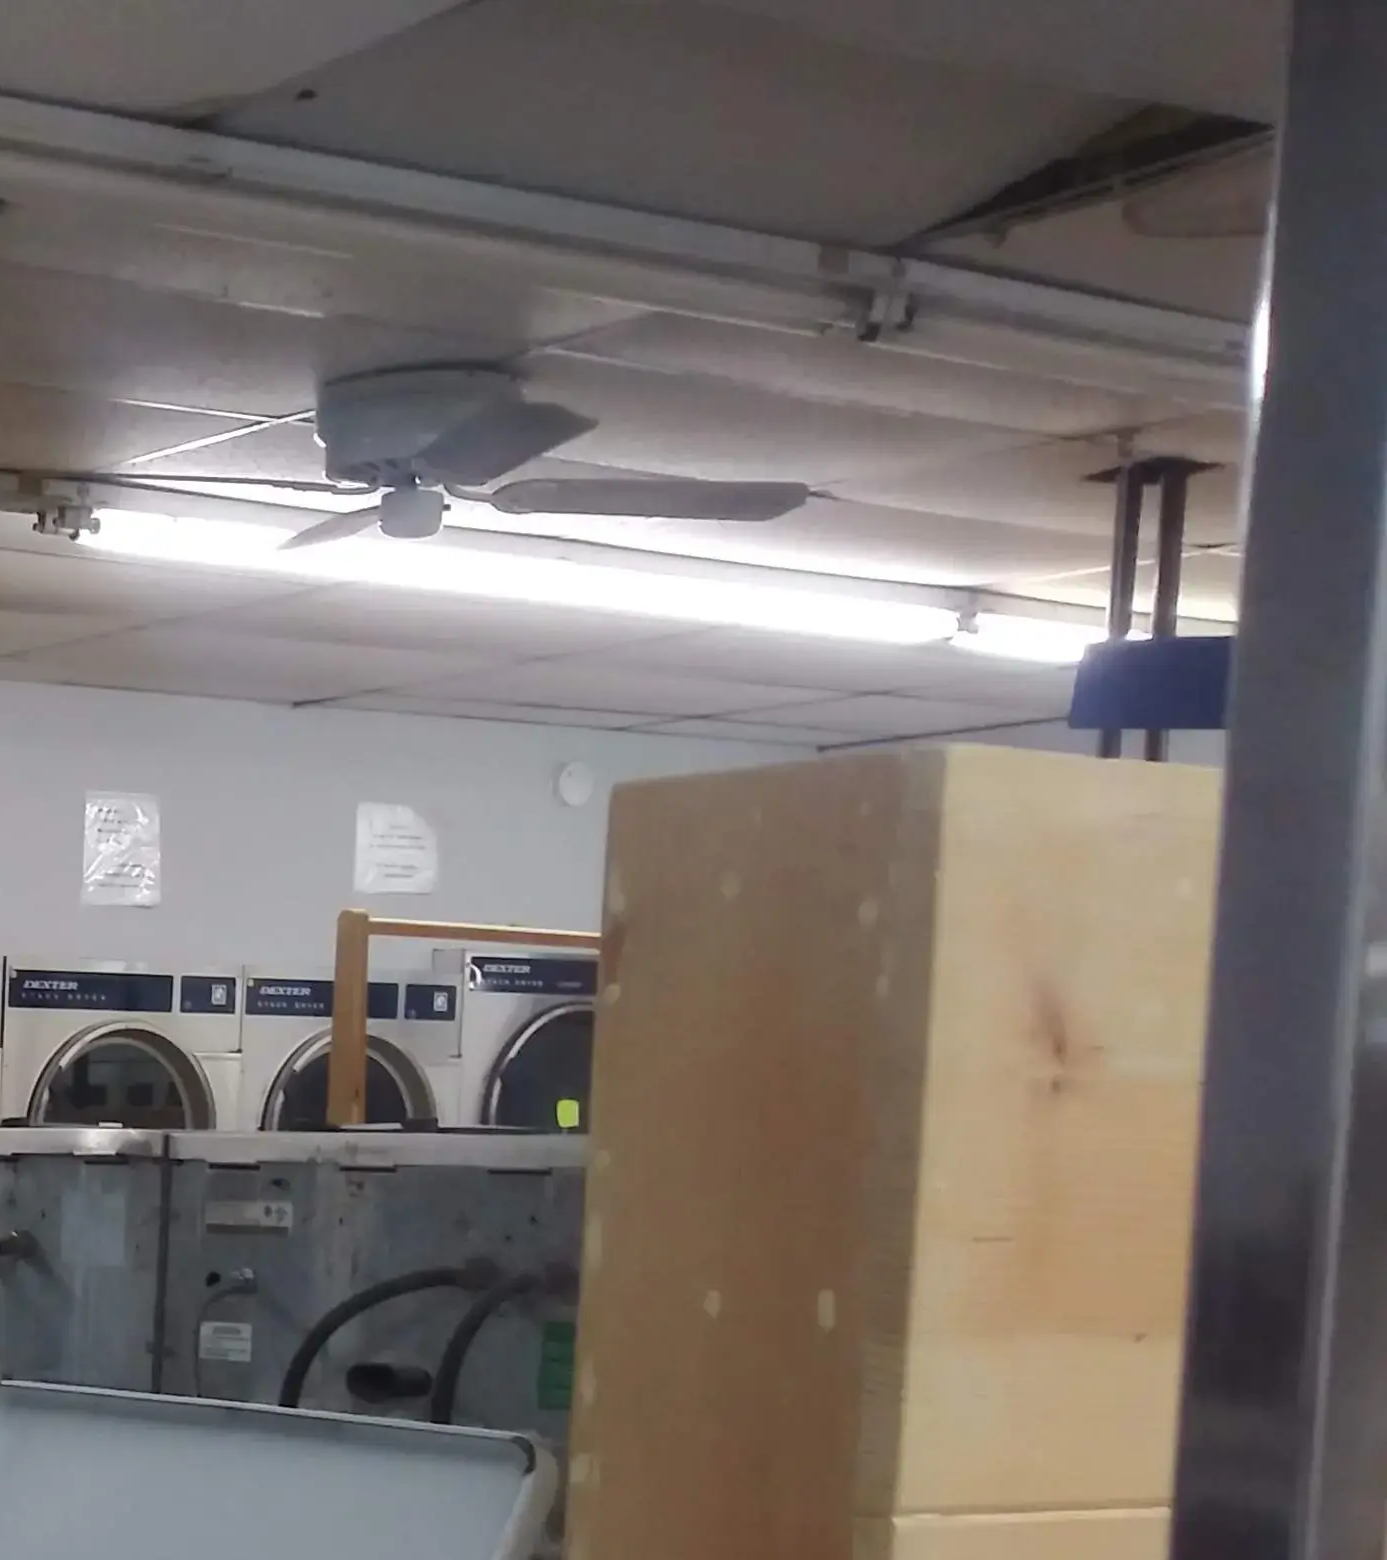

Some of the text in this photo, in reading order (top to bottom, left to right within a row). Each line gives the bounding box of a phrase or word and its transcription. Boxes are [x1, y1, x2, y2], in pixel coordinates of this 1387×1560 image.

[482, 963, 531, 974] DEXTER
[22, 979, 79, 991] DEXTER
[258, 985, 312, 996] DEXTER
